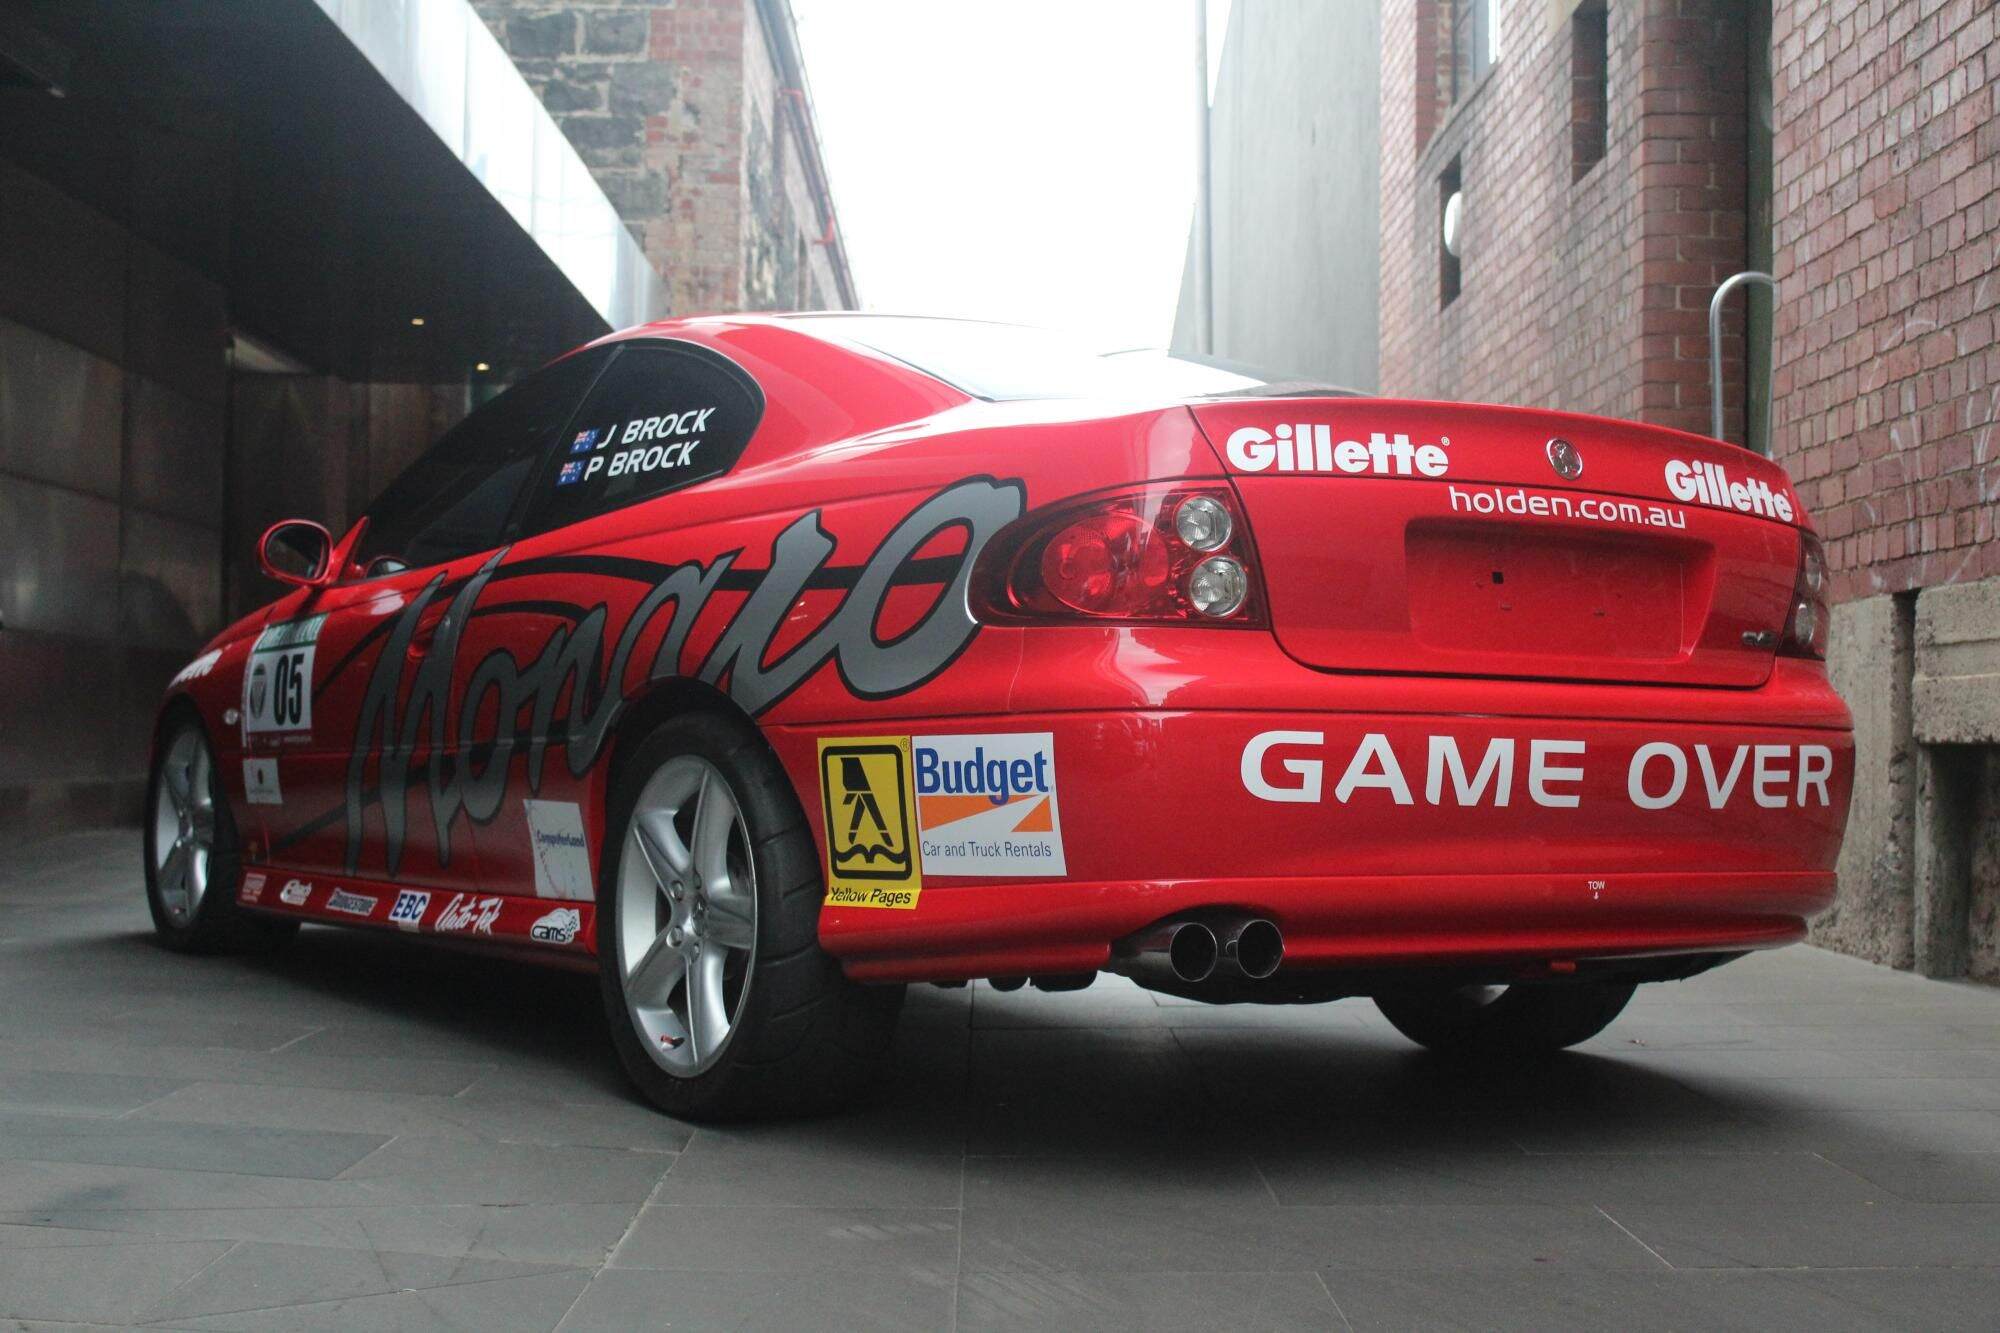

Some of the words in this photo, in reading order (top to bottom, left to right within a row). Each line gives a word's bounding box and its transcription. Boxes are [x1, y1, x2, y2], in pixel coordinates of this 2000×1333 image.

[596, 424, 617, 450] J
[621, 407, 717, 444] BROCK
[1226, 424, 1449, 477] Gillette
[584, 456, 604, 481] P
[607, 440, 700, 477] BROCK
[1449, 486, 1687, 530] holden.com.au
[1665, 459, 1794, 522] Gillette
[274, 653, 305, 726] 05
[346, 475, 1028, 878] Monaro
[915, 746, 1049, 806] Budget
[1240, 730, 1586, 808] GAME
[1627, 742, 1833, 810] OVER
[923, 840, 940, 857] Car
[945, 841, 967, 857] and
[969, 841, 1001, 858] Truck
[1004, 841, 1052, 858] Rentals
[392, 892, 428, 921] EBC
[830, 887, 868, 903] Yellow
[870, 889, 912, 907] Pages
[1587, 880, 1606, 891] TOW
